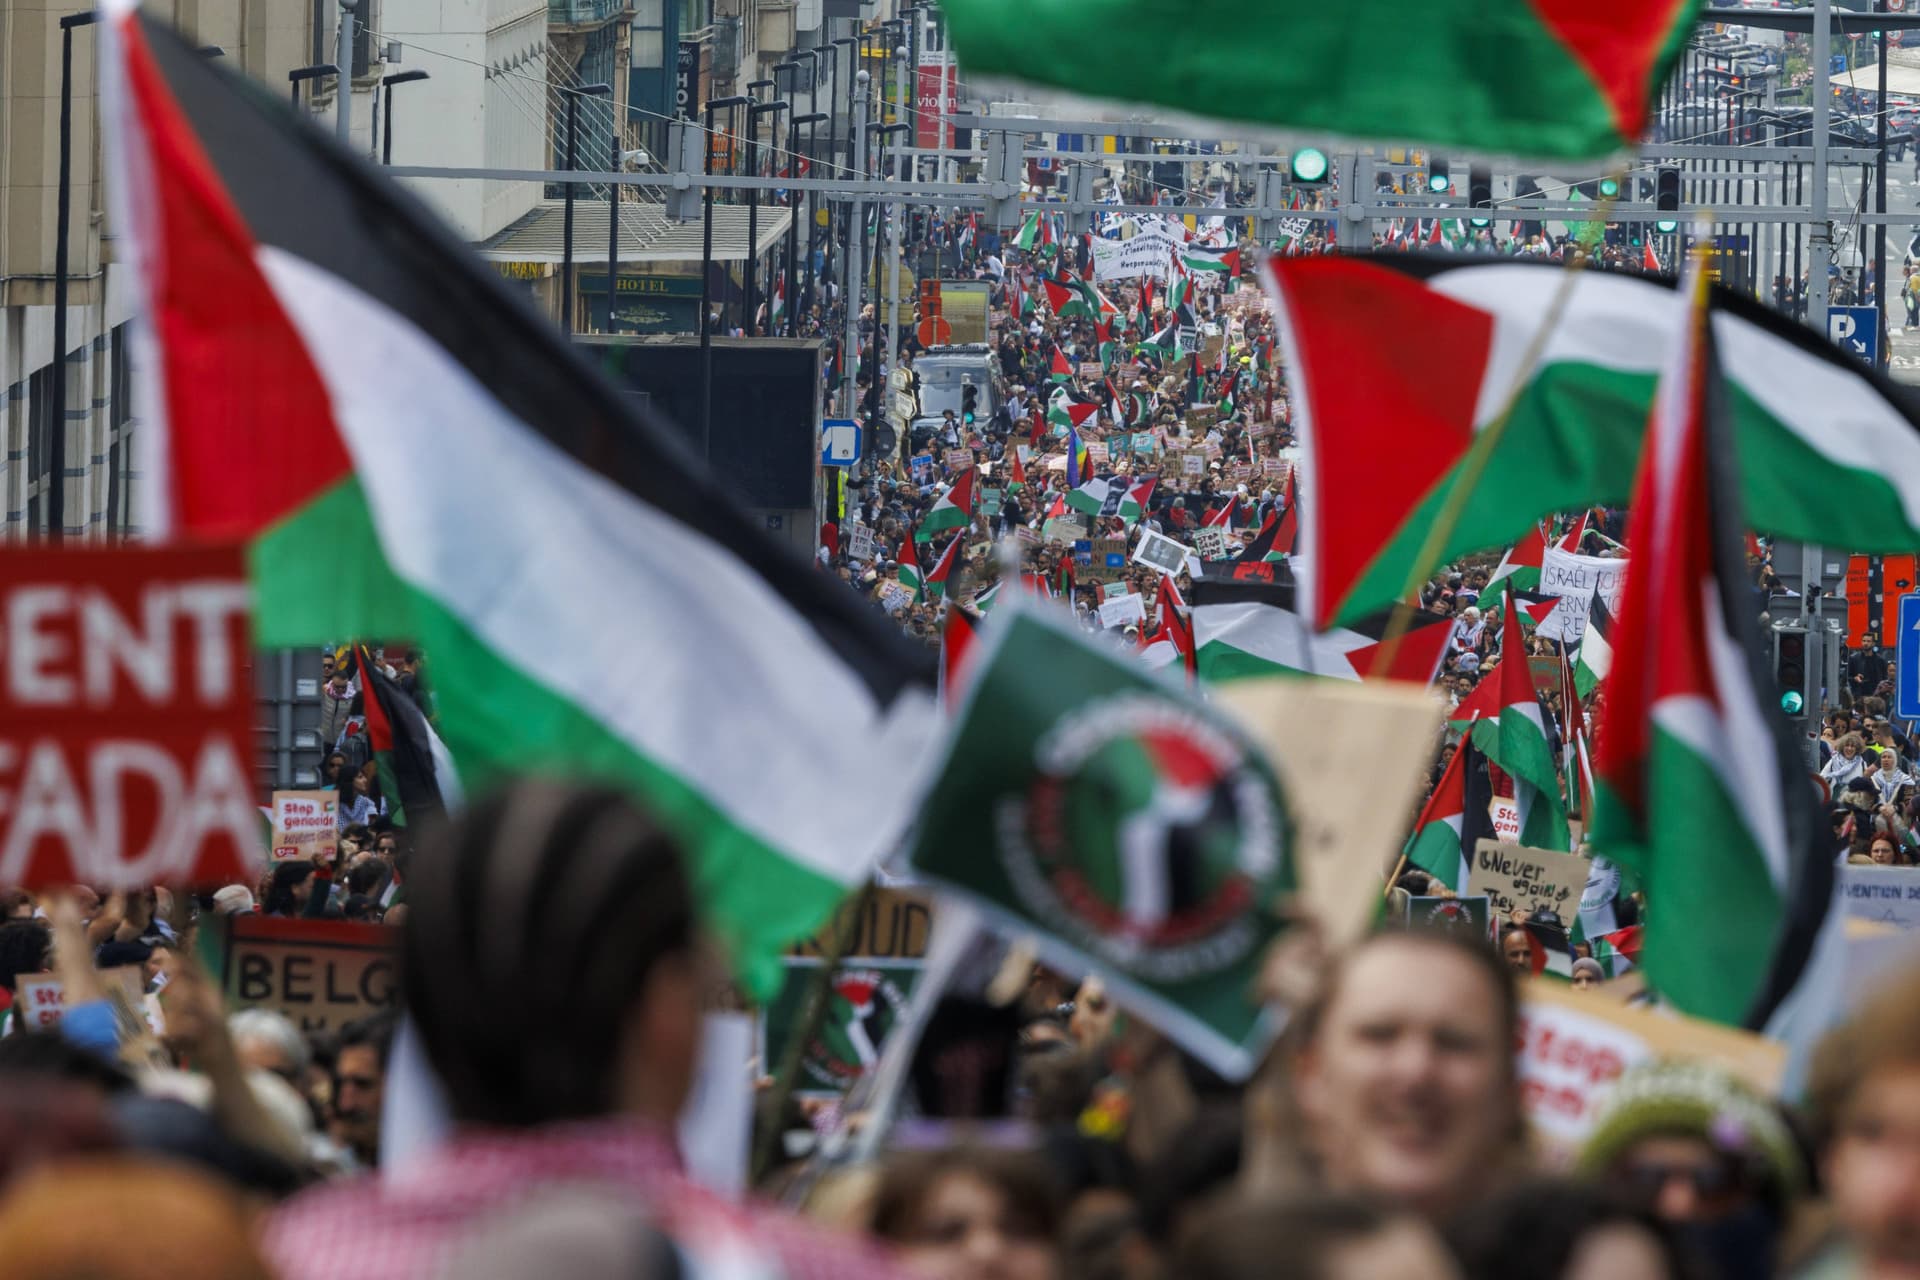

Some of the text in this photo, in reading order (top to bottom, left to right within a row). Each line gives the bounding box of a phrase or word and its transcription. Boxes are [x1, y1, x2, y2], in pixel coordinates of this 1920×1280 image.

[918, 93, 957, 108] vion
[616, 279, 668, 293] HOTEL
[1830, 314, 1856, 347] P
[1545, 565, 1590, 590] ISRAËL
[8, 581, 258, 704] ENT
[284, 803, 314, 816] Stop
[284, 813, 334, 830] genocide
